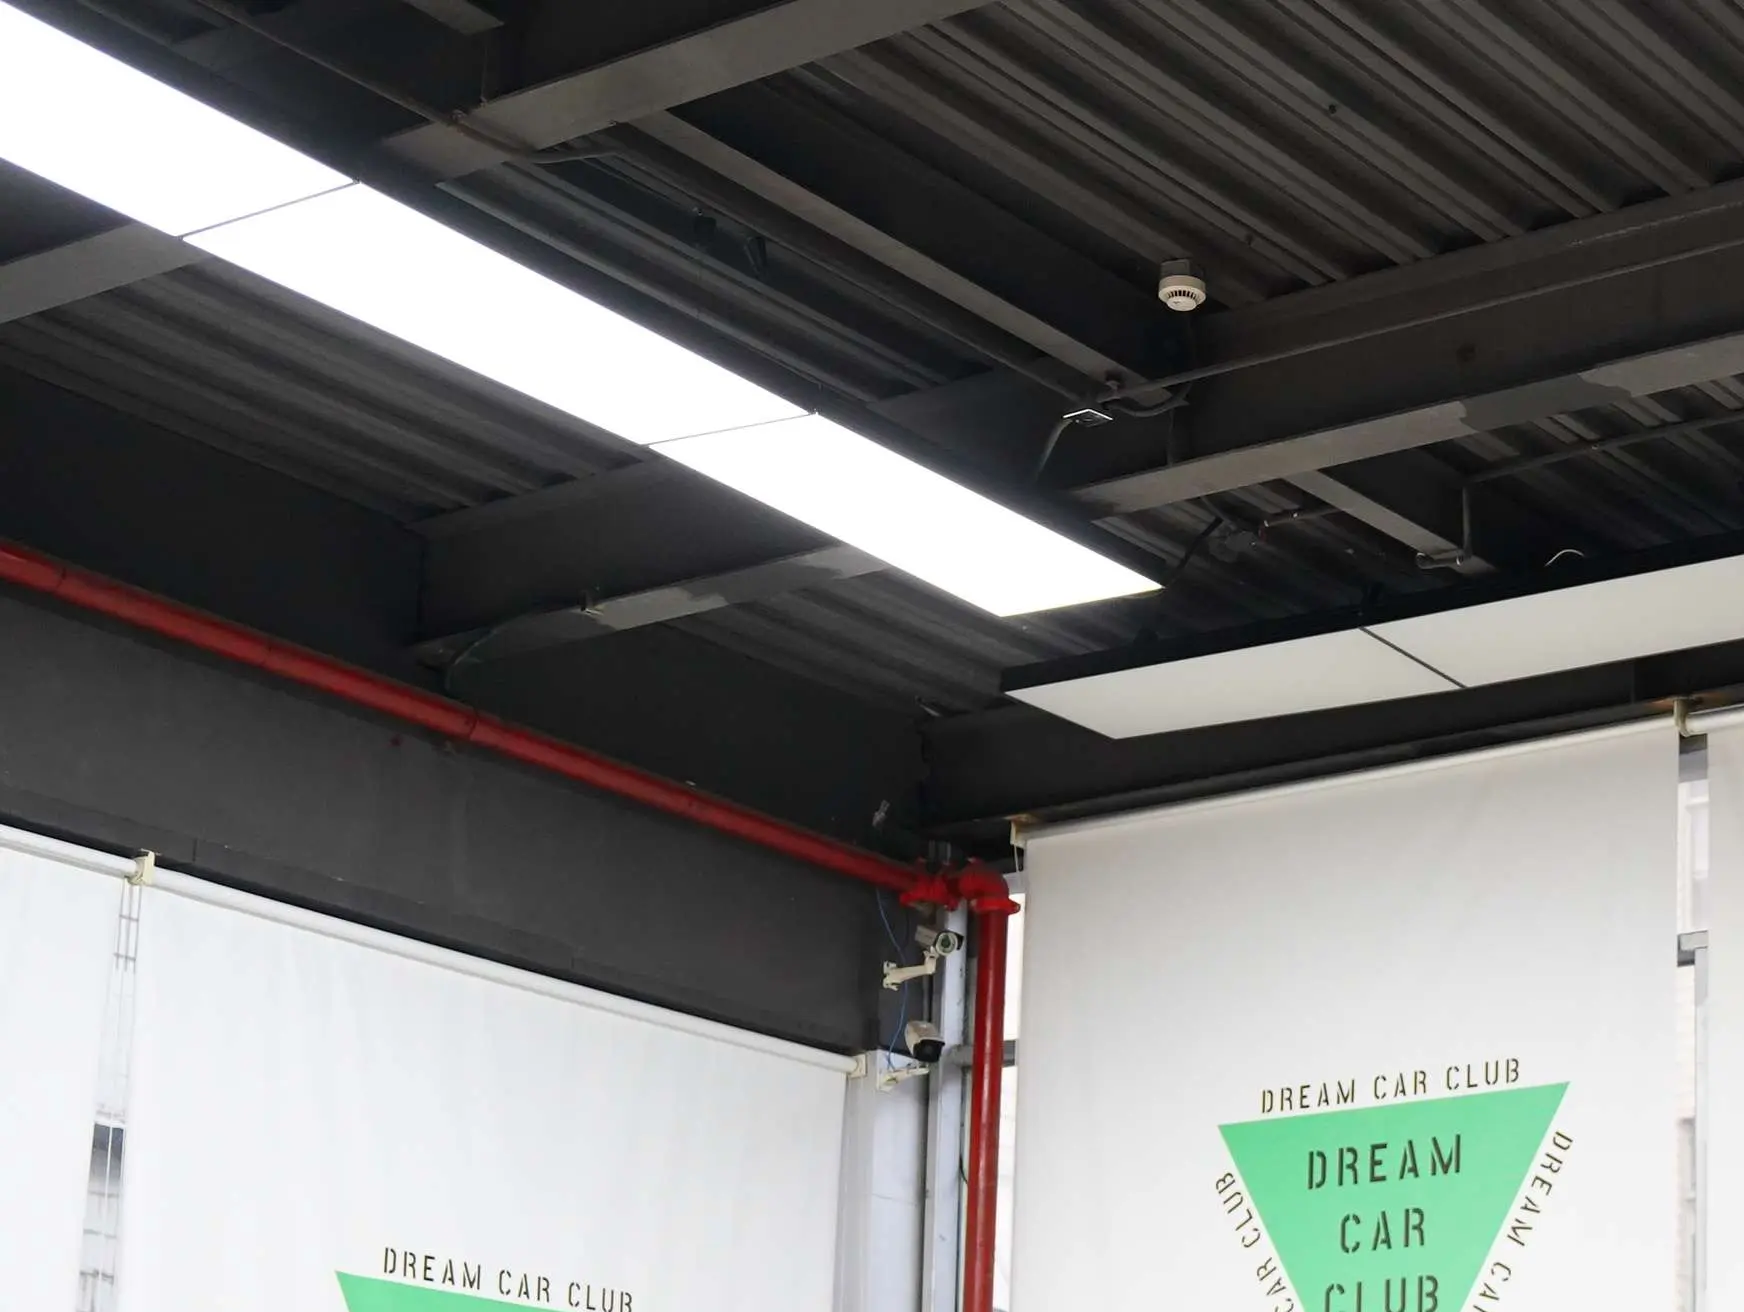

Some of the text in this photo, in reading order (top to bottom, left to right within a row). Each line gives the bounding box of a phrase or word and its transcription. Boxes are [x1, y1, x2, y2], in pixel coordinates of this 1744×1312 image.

[1262, 1059, 1518, 1113] DREAM CAR CLUB
[1308, 1134, 1460, 1190] DREAM
[1507, 1132, 1573, 1246] DREAM
[1216, 1173, 1260, 1247] CLUB
[1341, 1208, 1424, 1253] CAR
[384, 1248, 480, 1290] DREAM
[499, 1270, 549, 1302] CAR
